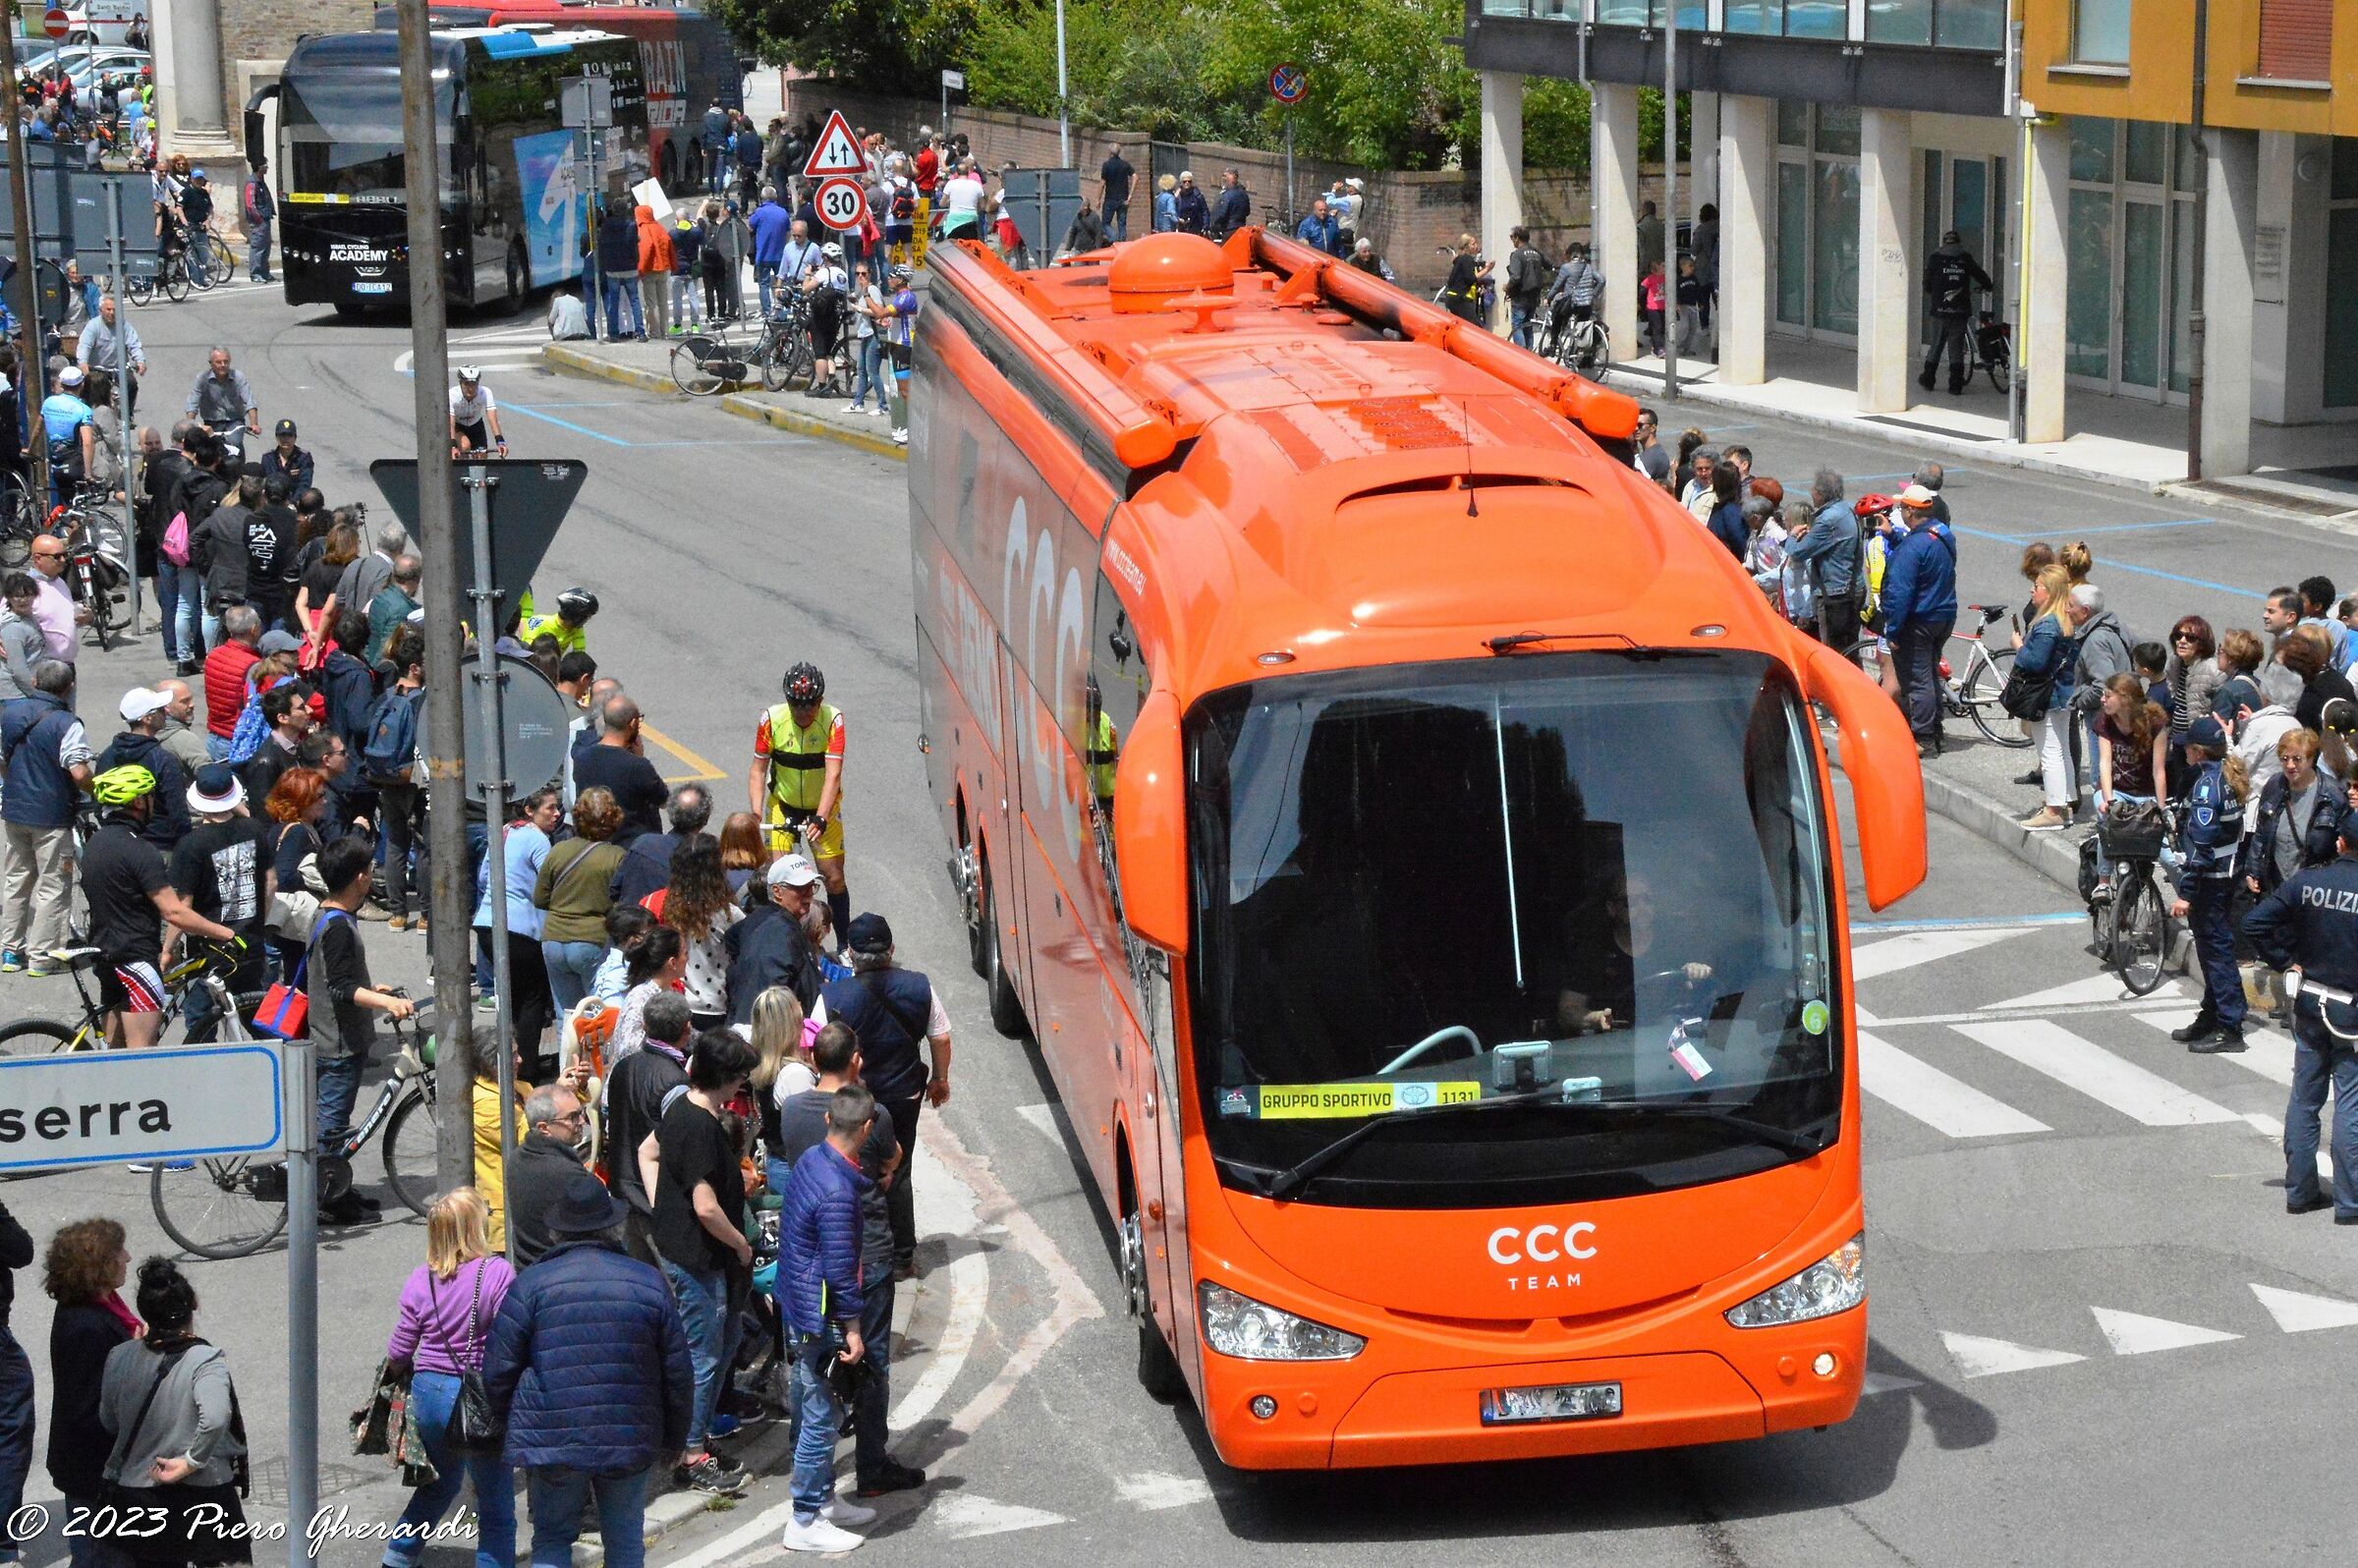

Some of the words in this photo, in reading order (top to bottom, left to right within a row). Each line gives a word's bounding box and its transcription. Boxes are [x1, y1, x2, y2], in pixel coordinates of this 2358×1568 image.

[827, 192, 855, 215] 30
[329, 250, 388, 261] ACADEMY
[2301, 885, 2358, 914] POLIZI
[1263, 1094, 1319, 1108] GRUPPO
[1322, 1092, 1391, 1107] SPORTIVO
[1442, 1092, 1475, 1104] 1131
[0, 1098, 172, 1143] serra
[1488, 1221, 1598, 1265] CCC
[1507, 1273, 1581, 1291] TEAM
